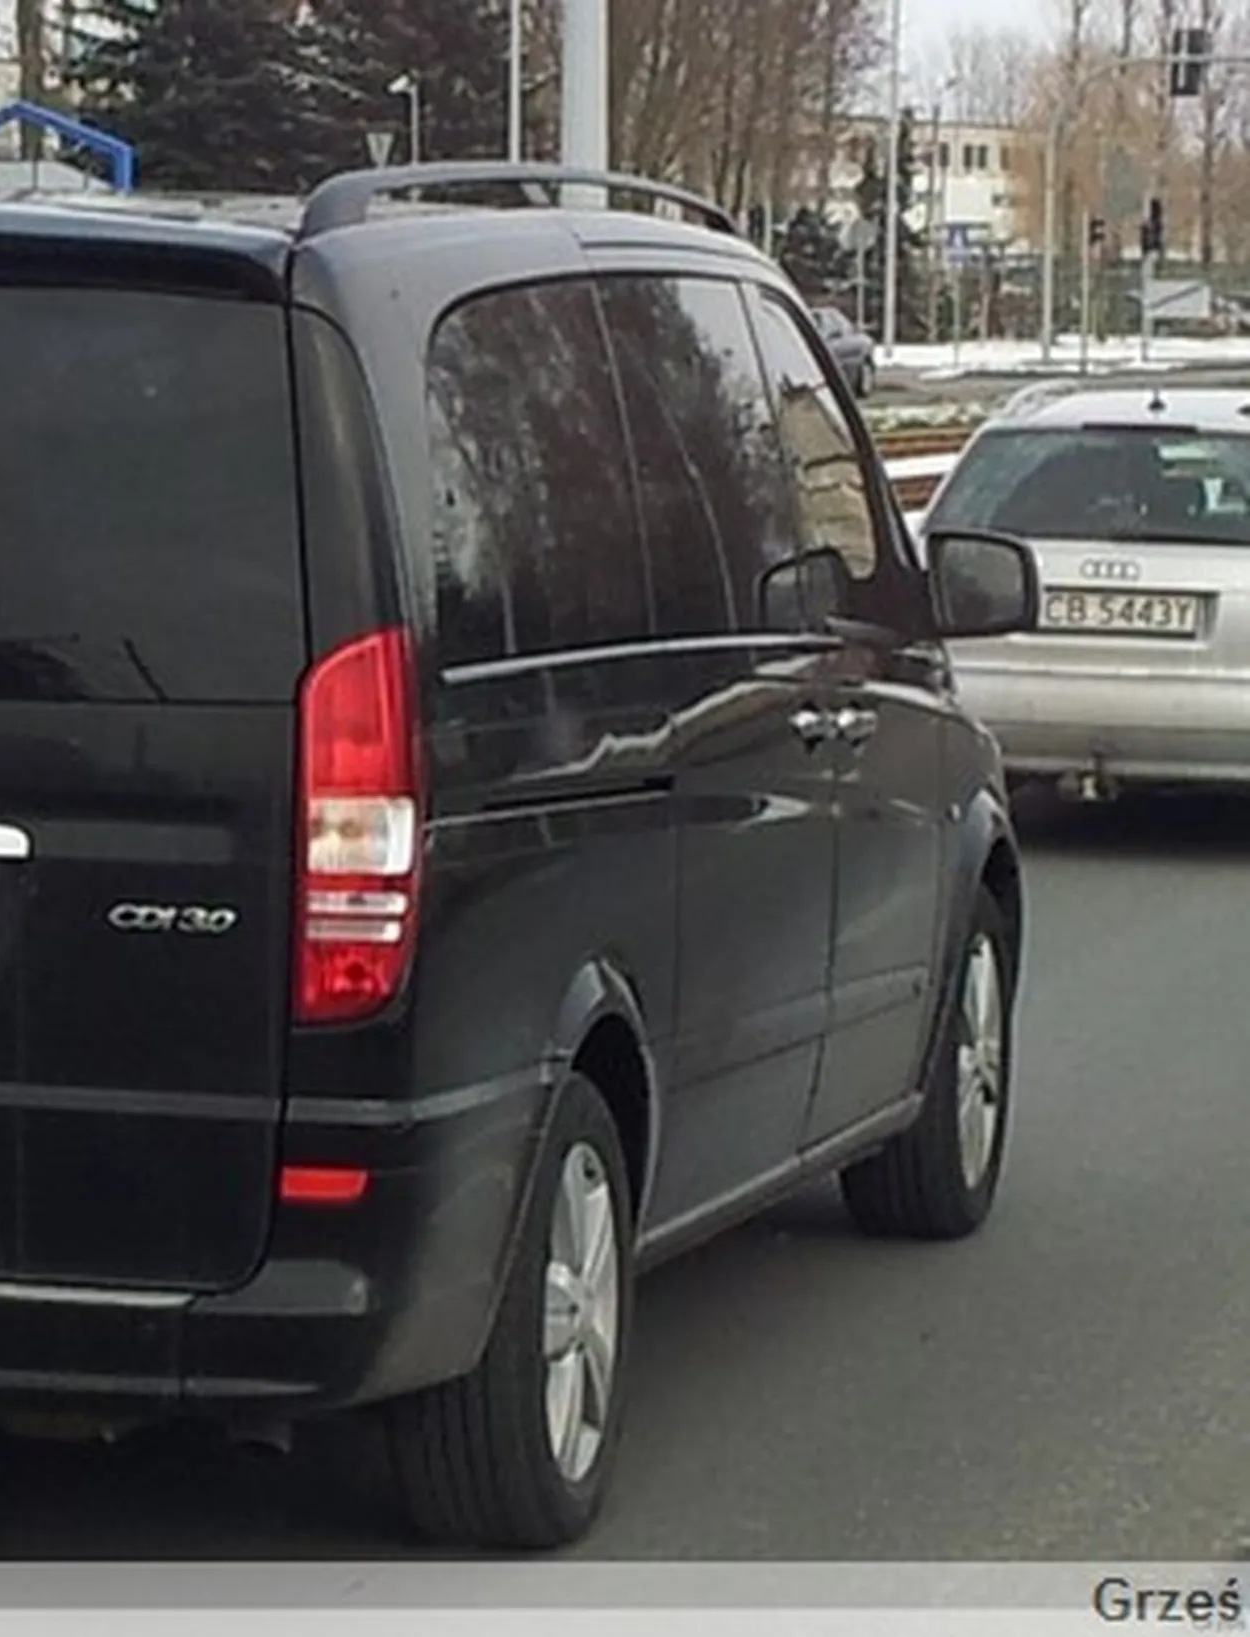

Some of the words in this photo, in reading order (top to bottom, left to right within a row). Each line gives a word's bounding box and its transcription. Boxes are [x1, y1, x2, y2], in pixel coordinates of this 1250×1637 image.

[1046, 594, 1086, 624] CB
[1098, 596, 1192, 626] 5443Y
[108, 903, 177, 930] CDI
